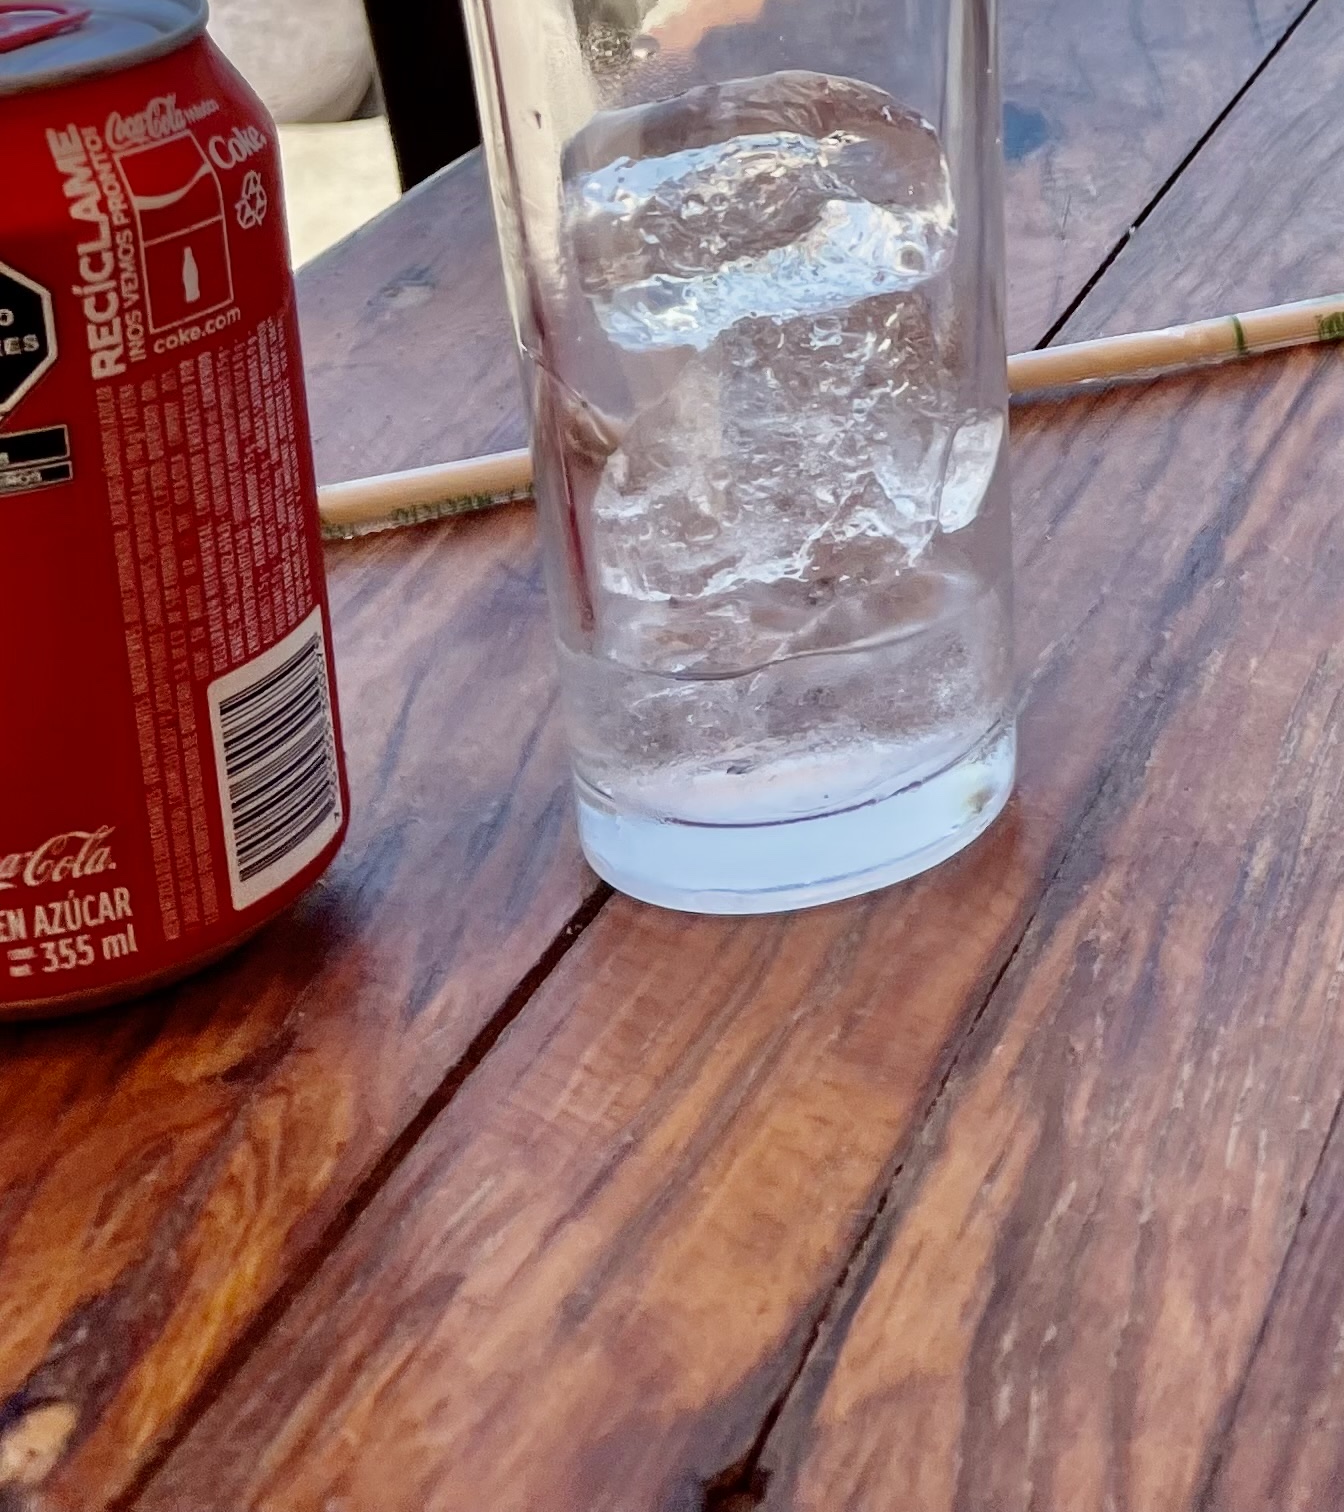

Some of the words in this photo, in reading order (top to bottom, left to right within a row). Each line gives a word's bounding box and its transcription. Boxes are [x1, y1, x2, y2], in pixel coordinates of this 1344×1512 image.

[46, 123, 126, 381] RECÍCLAME
[116, 228, 140, 309] VEMOS
[153, 306, 241, 355] coke.com
[34, 887, 133, 938] AZÚCAR
[39, 934, 95, 973] 355
[101, 923, 138, 960] ml
